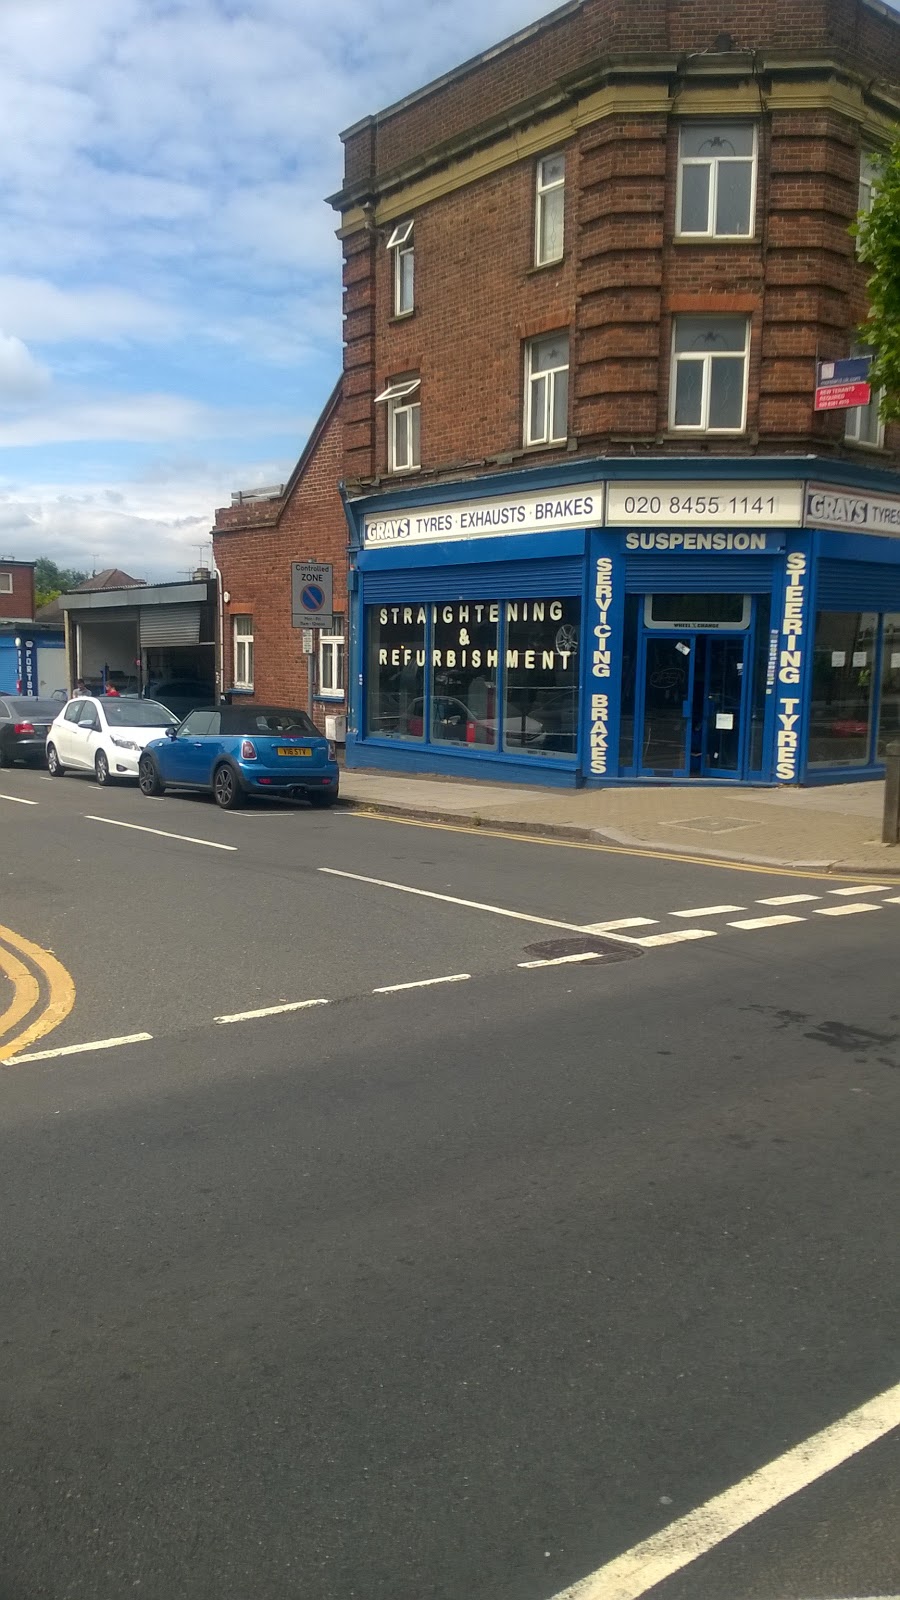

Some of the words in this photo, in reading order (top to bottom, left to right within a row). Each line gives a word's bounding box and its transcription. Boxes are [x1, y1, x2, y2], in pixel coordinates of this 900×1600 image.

[624, 496, 661, 514] 020
[669, 496, 720, 514] 8455
[729, 496, 776, 514] 1141
[810, 493, 868, 525] GRAYS
[366, 518, 409, 541] GRAYS
[416, 515, 453, 534] TYRES
[460, 505, 526, 529] EXHAUSTS
[535, 496, 594, 520] BRAKES
[625, 533, 766, 550] SUSPENSION
[295, 564, 329, 573] Controlled
[301, 574, 323, 582] ZONE
[379, 601, 563, 625] STRAIGHTENING
[592, 557, 613, 678] SERVICING
[778, 552, 806, 684] STEERING
[459, 627, 471, 646] &
[379, 648, 571, 670] REFURBISHMENT
[590, 694, 608, 774] BRAKES
[776, 698, 800, 780] TYRES
